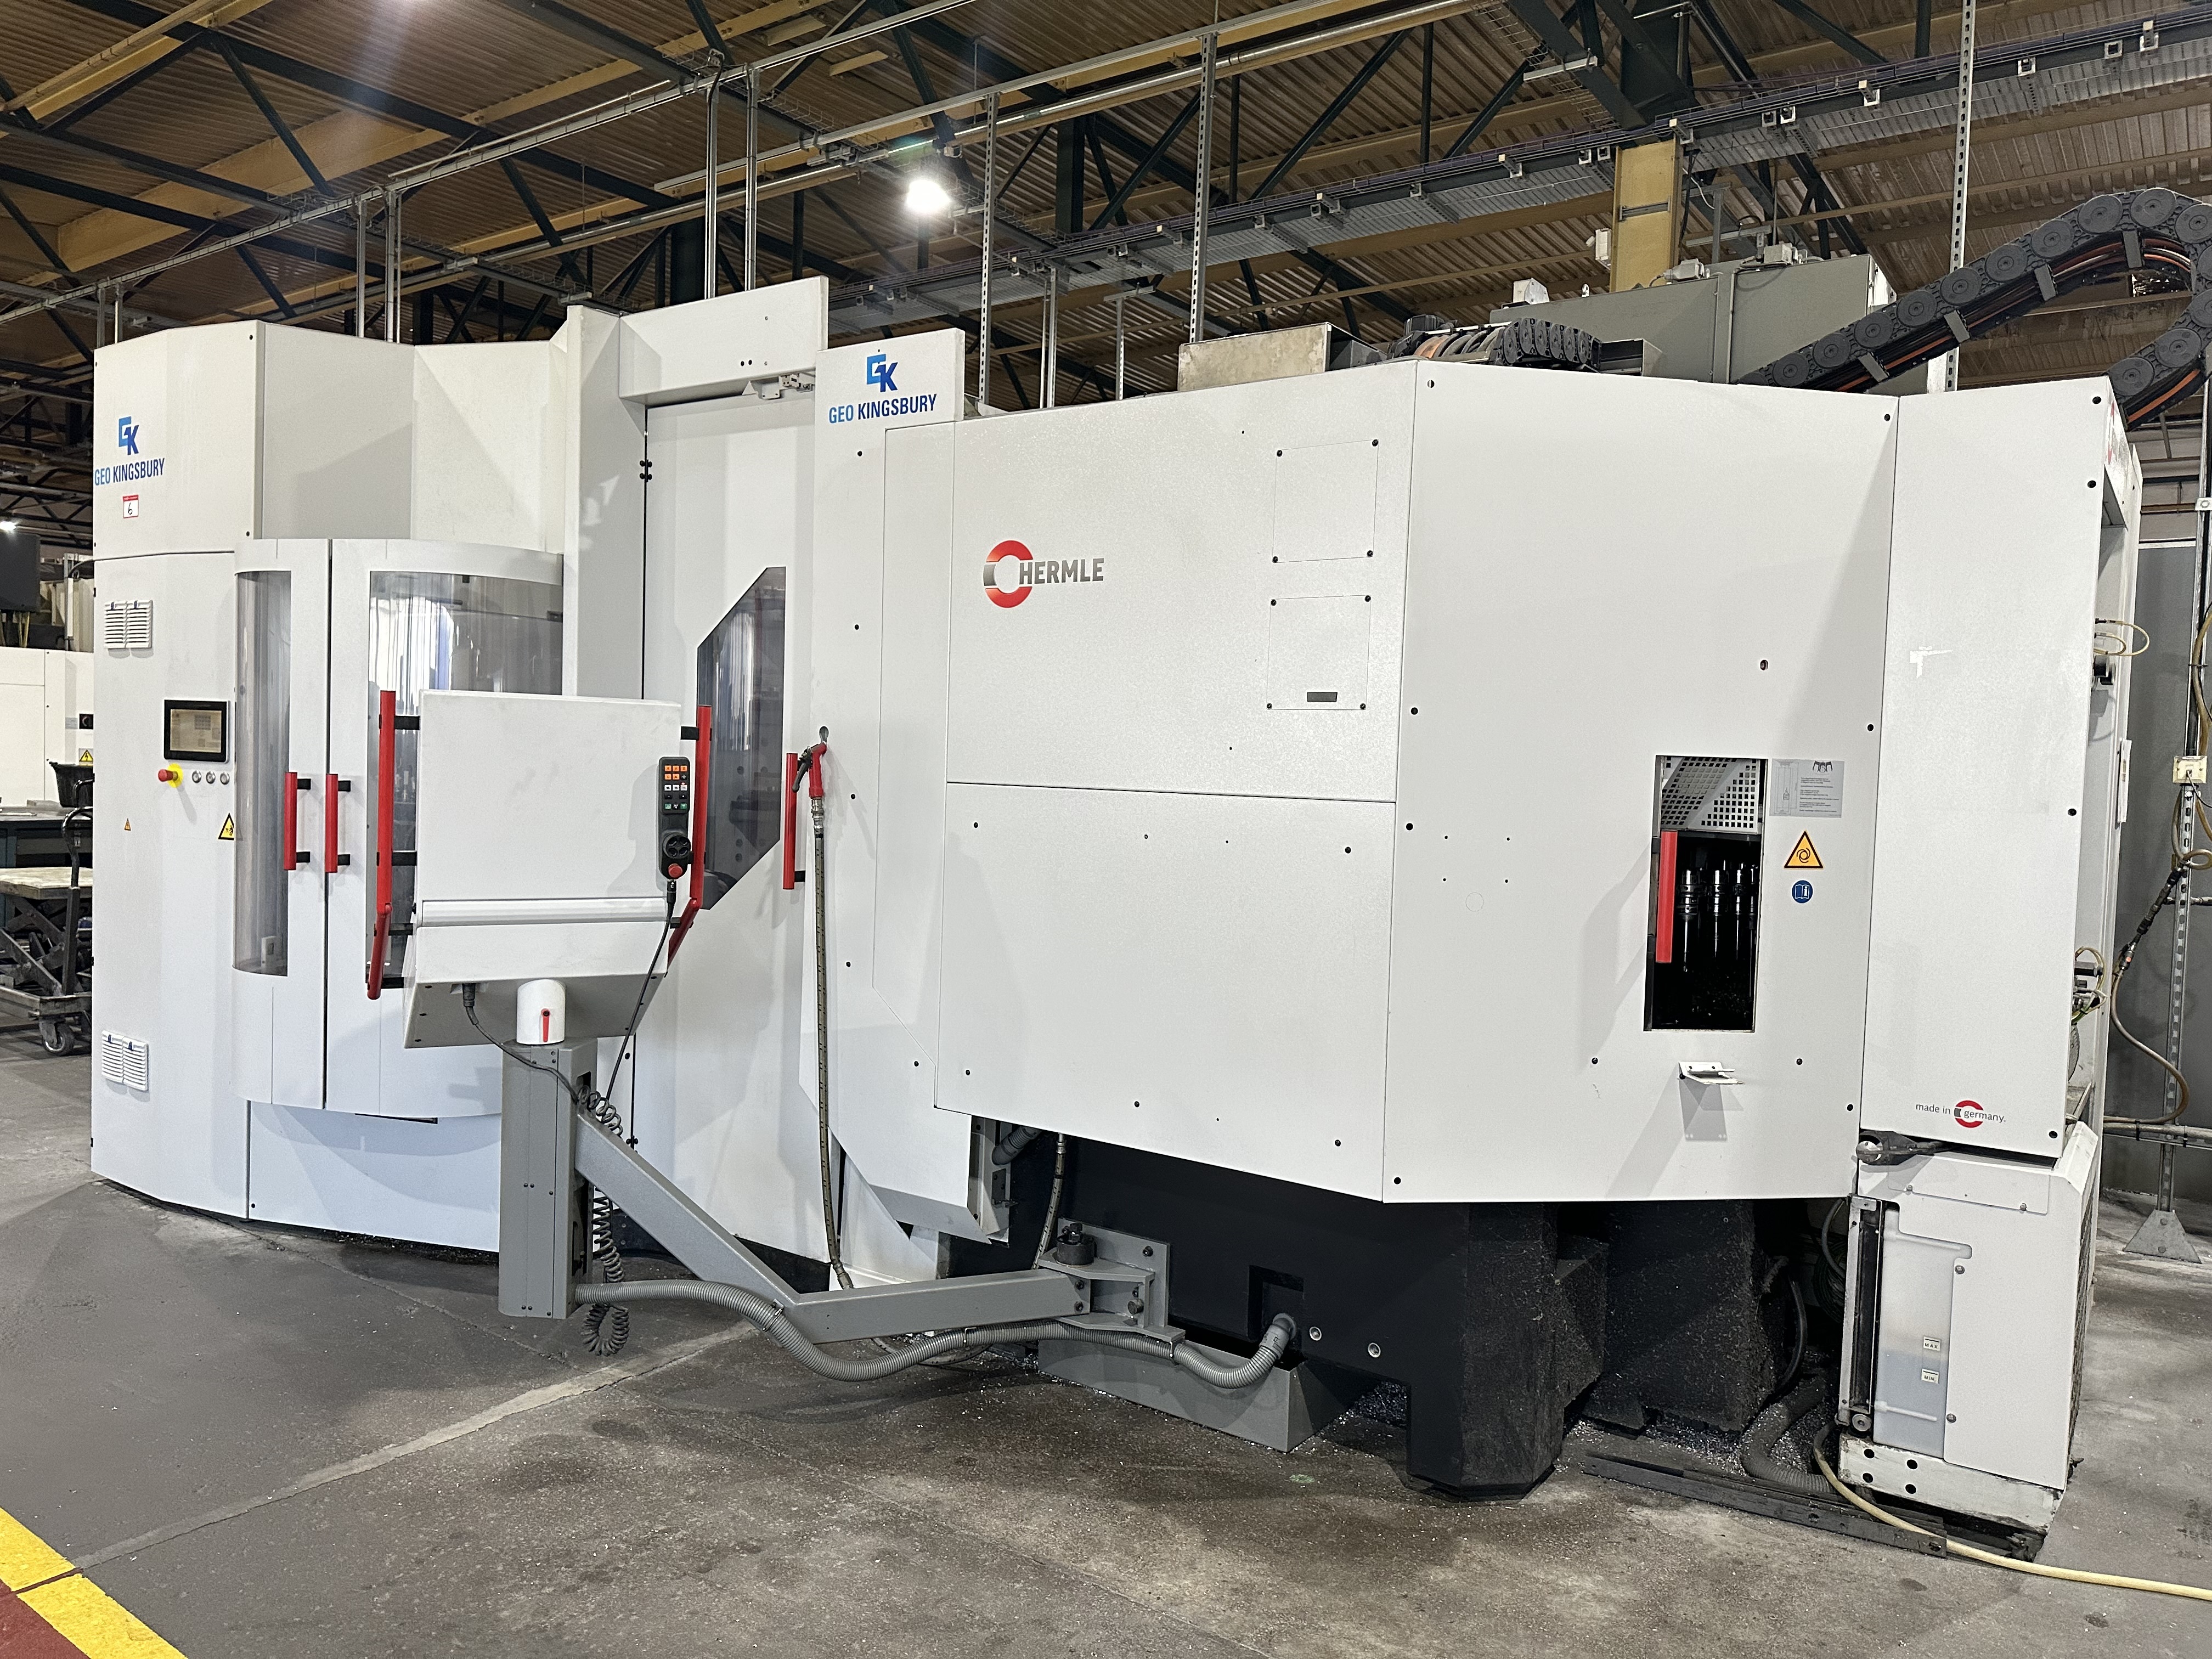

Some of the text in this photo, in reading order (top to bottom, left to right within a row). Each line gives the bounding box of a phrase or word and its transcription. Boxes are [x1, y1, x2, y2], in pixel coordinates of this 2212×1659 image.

[829, 393, 937, 424] GEO KINGSBURY
[94, 458, 165, 486] GEO KINGSBURY
[127, 502, 133, 515] 6
[1019, 557, 1104, 585] HERMLE
[1916, 1104, 1940, 1113] made
[1943, 1105, 1951, 1114] in
